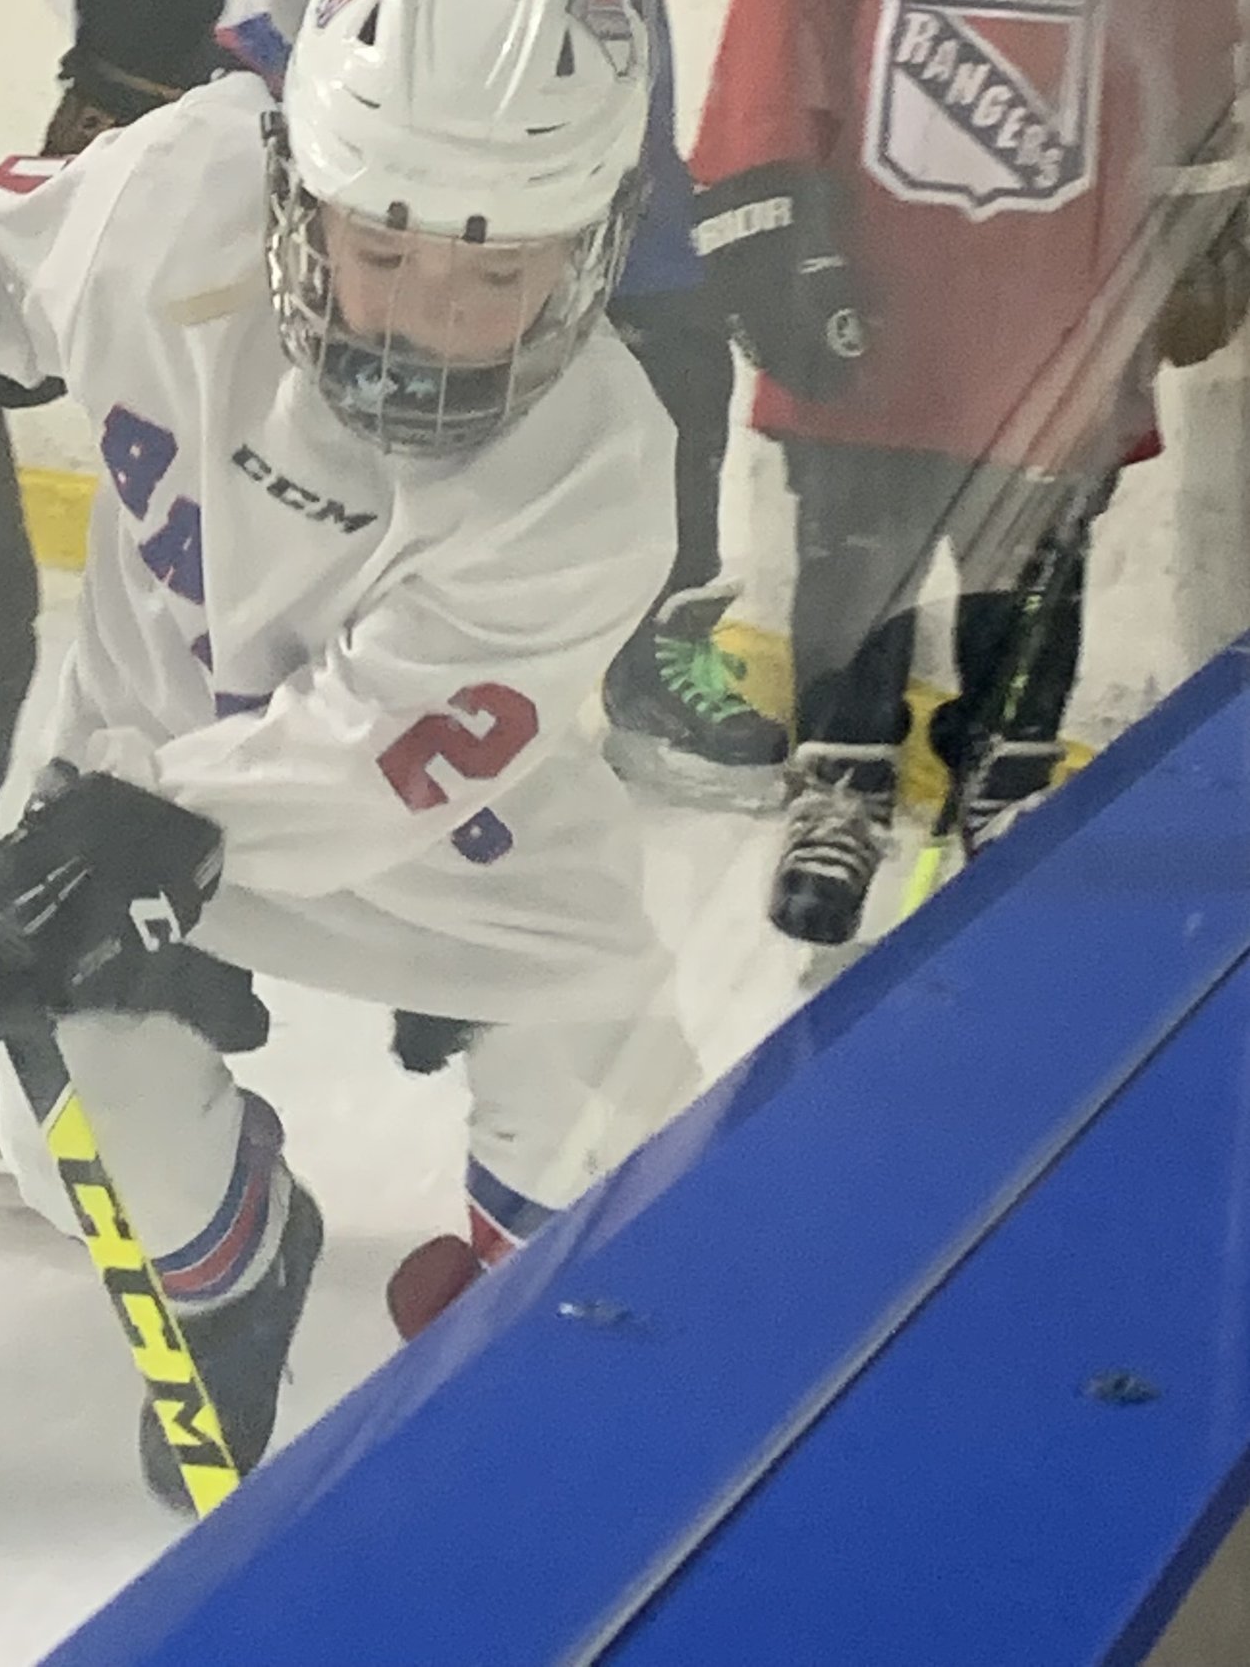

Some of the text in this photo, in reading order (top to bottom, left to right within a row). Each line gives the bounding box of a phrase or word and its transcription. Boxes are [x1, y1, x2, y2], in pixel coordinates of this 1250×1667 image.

[894, 11, 1065, 189] RANGERS
[232, 443, 378, 534] CCM
[58, 1156, 235, 1470] CCM
